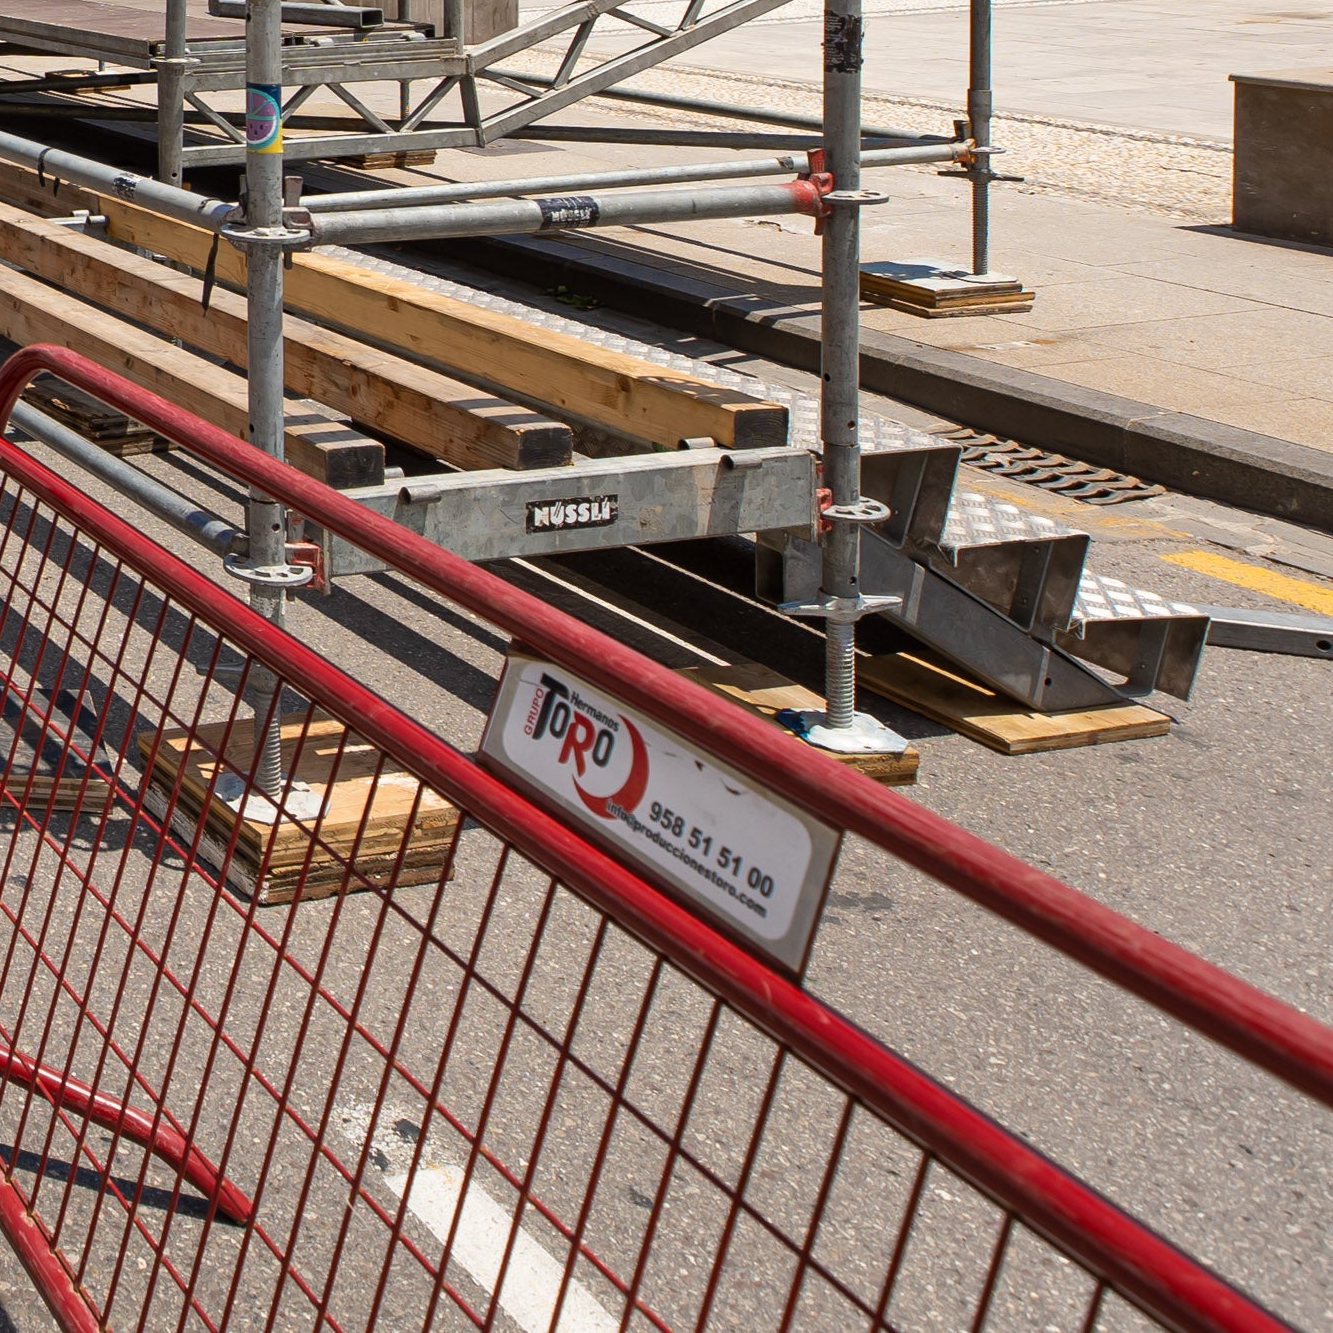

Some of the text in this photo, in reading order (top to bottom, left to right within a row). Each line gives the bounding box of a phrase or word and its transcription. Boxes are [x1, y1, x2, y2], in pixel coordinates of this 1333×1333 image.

[523, 687, 545, 736] GRUPO
[570, 690, 620, 733] Hermanos
[605, 800, 768, 919] info@produccionestoro.com
[648, 801, 775, 899] 958 51 51 00
